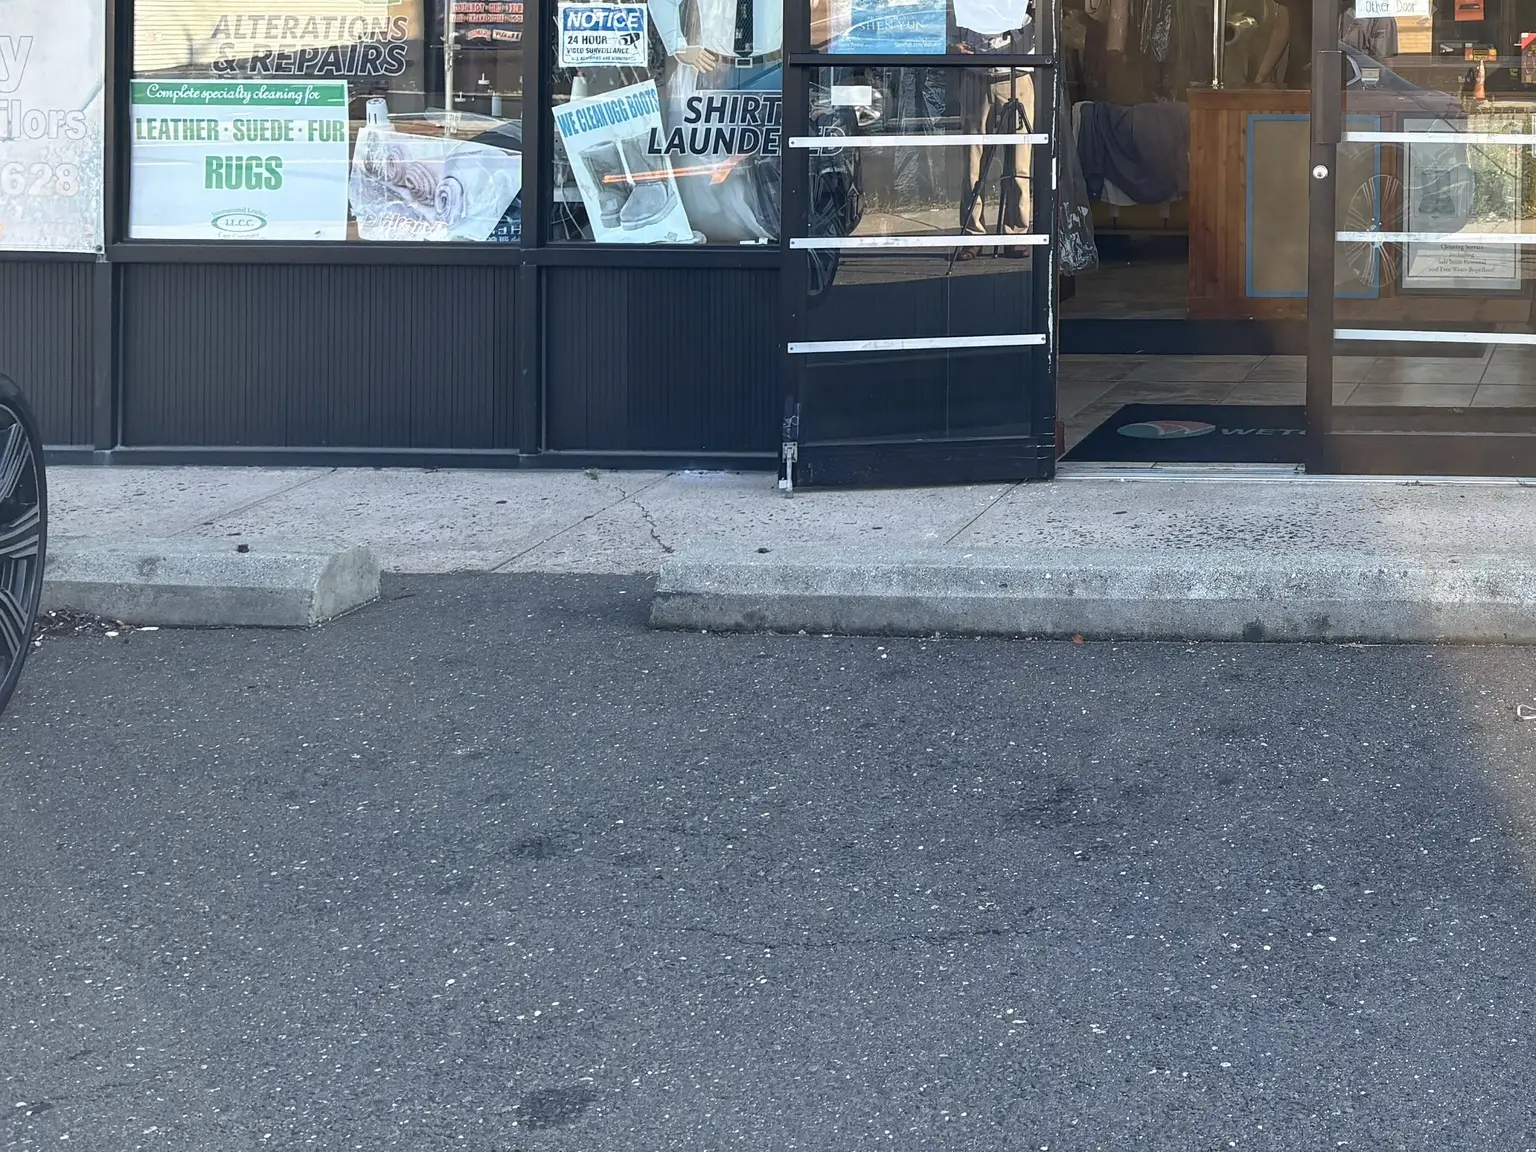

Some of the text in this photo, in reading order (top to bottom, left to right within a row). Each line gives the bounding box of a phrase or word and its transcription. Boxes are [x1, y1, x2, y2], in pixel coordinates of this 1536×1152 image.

[211, 14, 409, 44] ALTERATIONS
[566, 11, 640, 29] NOTICE
[567, 35, 608, 45] 24 HOUR
[211, 42, 408, 76] & REPAIRS
[146, 83, 321, 104] Complete specialty cleaning for
[556, 88, 660, 138] WE CLEAN UGG BOOTS
[683, 95, 783, 125] SHIRT
[136, 118, 345, 142] LEATHER SUEDE FUR
[204, 155, 283, 190] RUGS
